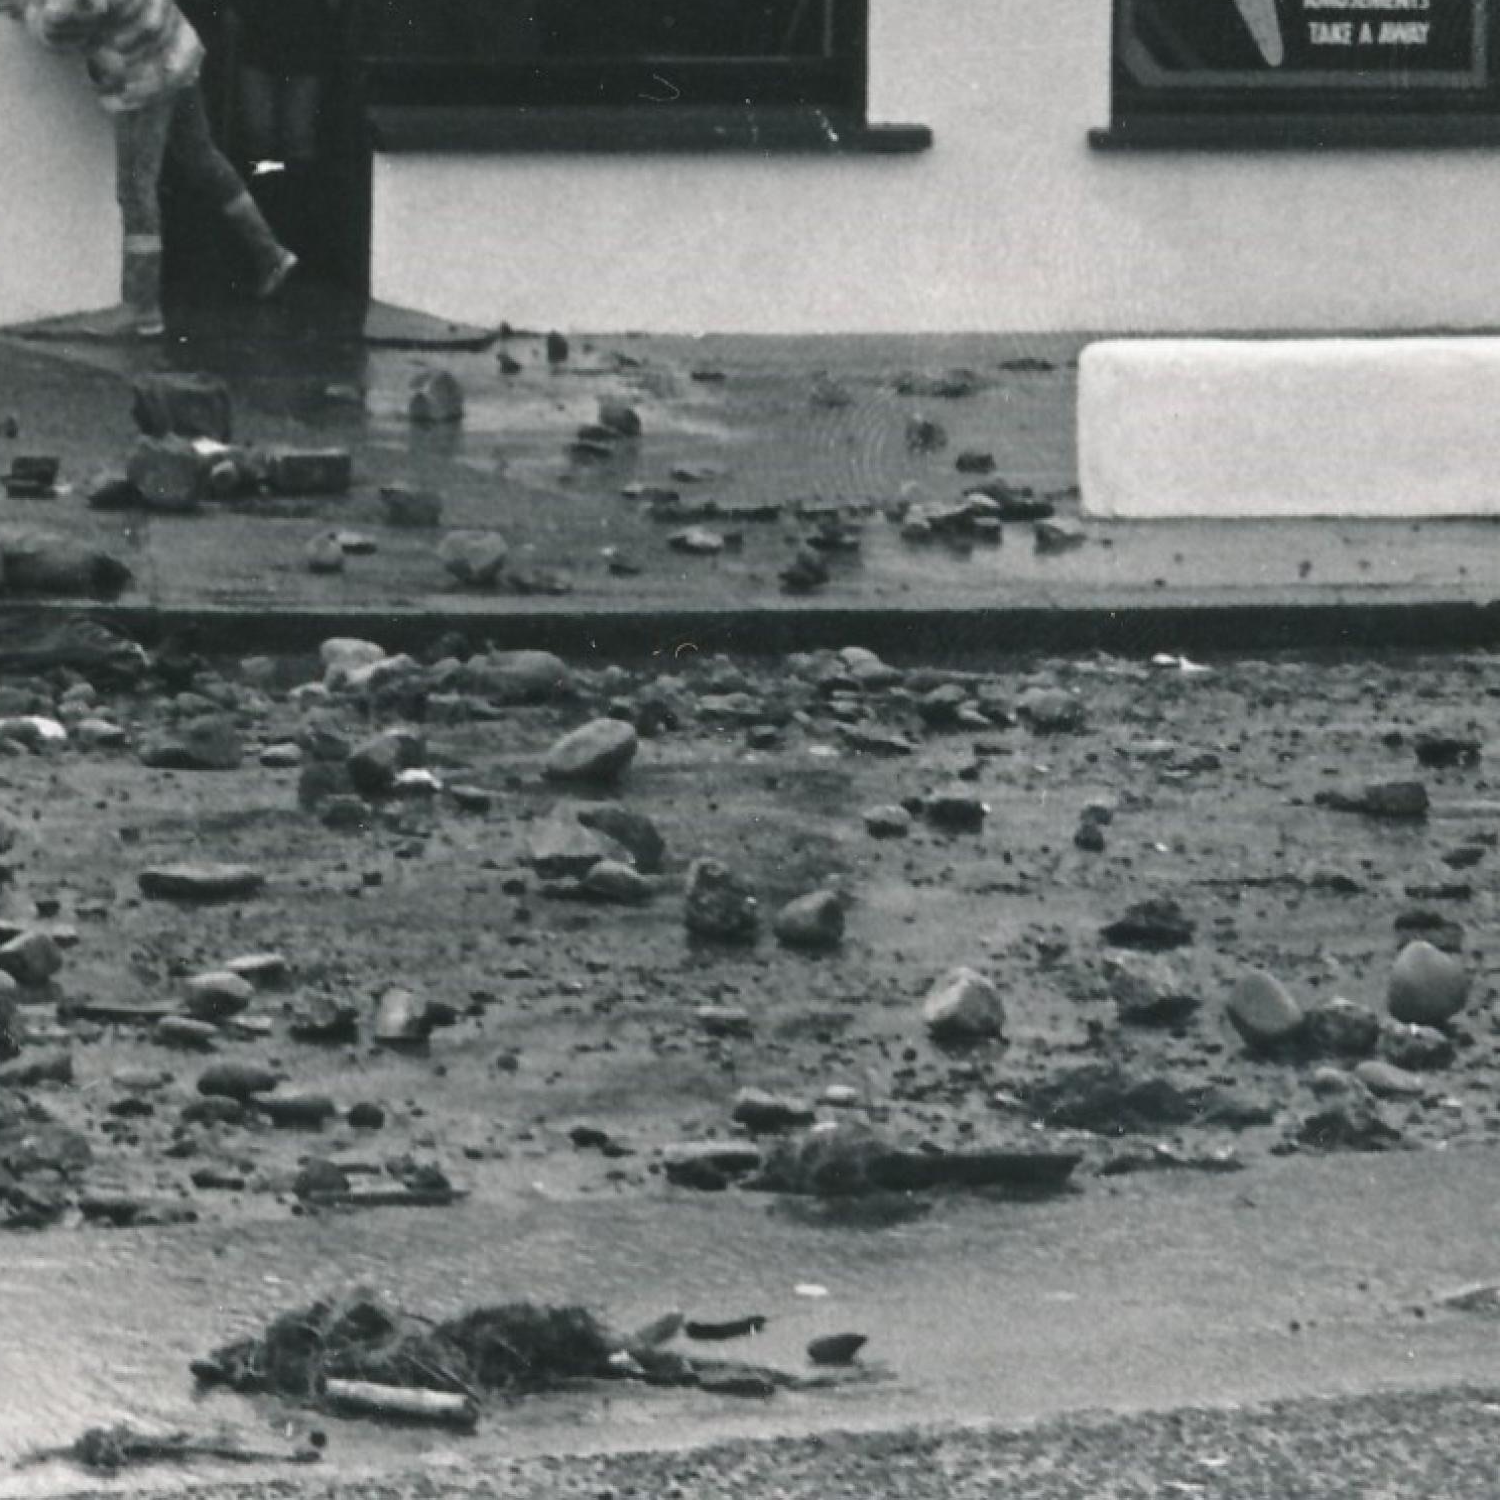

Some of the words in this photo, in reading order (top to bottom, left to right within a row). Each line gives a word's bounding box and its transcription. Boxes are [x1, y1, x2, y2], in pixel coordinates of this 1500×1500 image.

[1309, 21, 1352, 45] TAKE
[1358, 21, 1373, 45] A
[1378, 21, 1430, 45] AWAY
